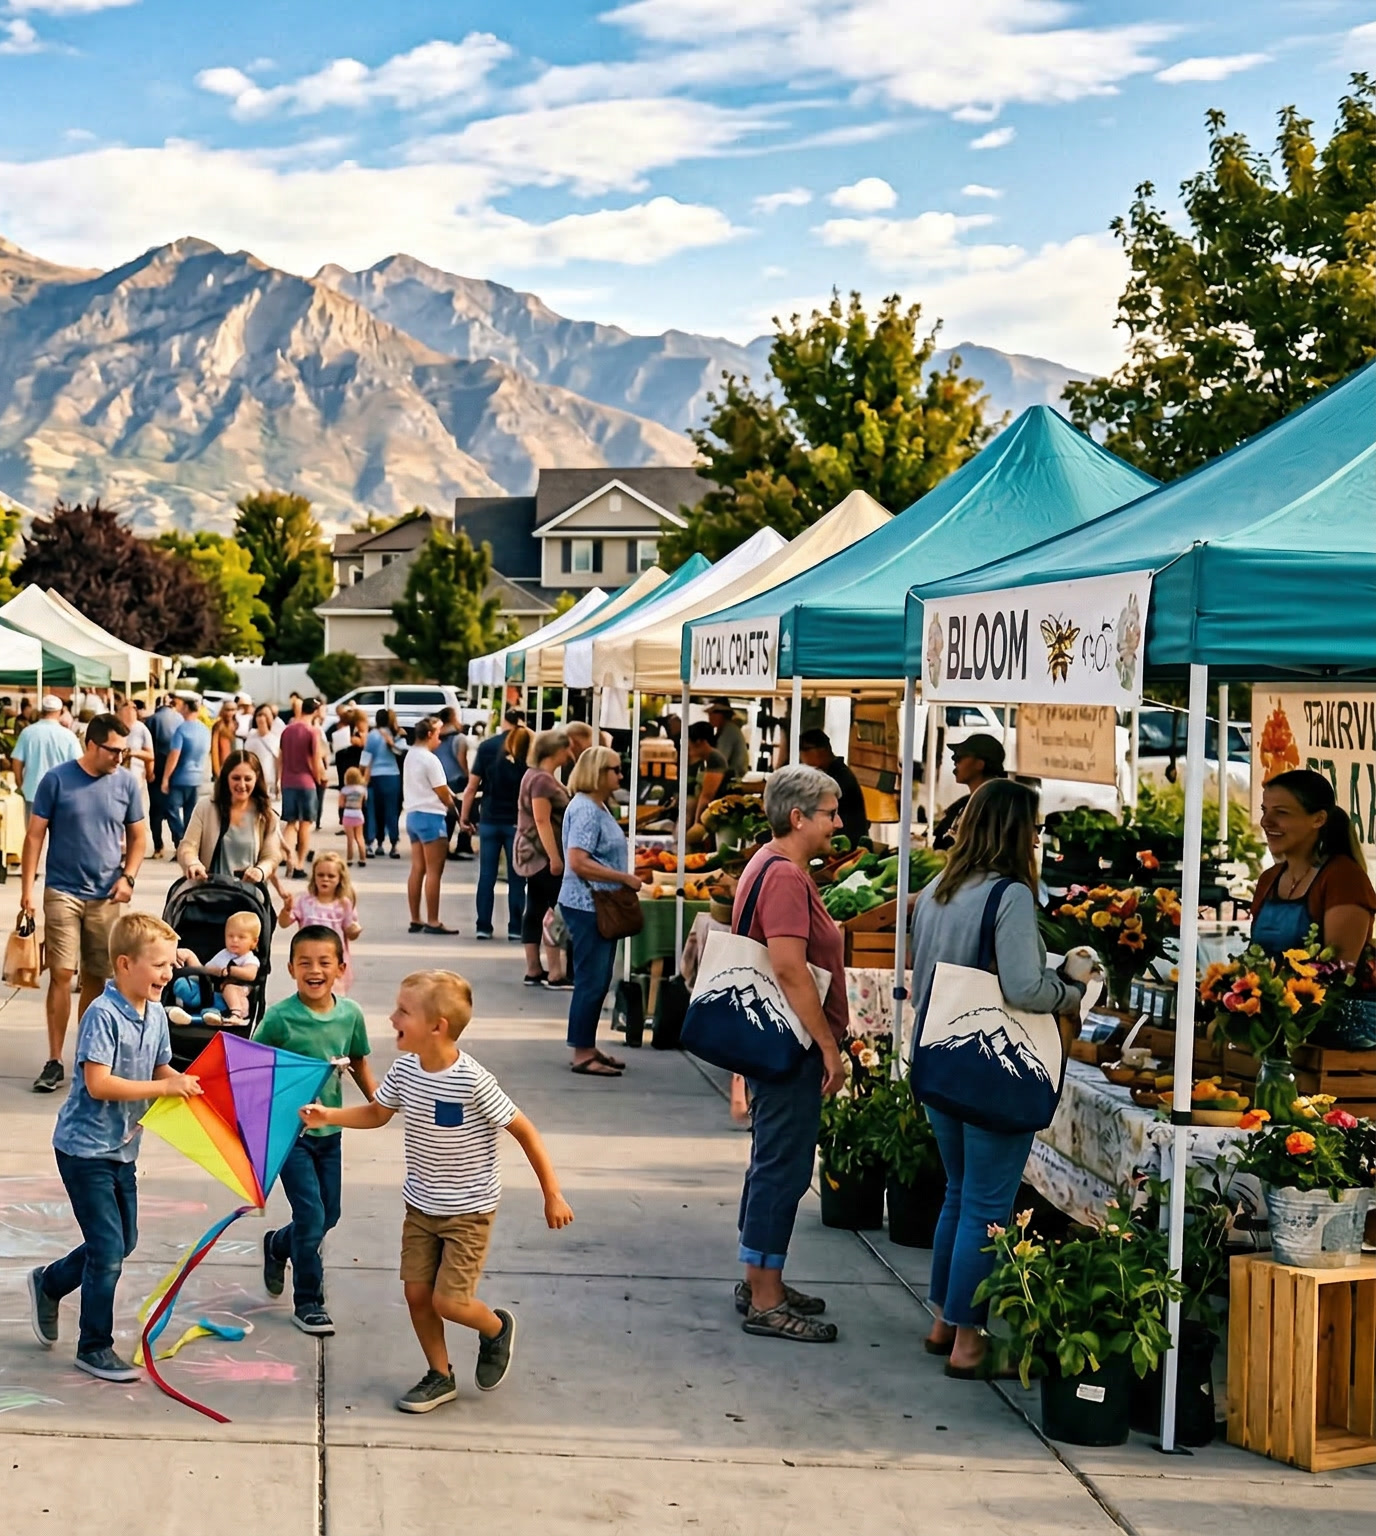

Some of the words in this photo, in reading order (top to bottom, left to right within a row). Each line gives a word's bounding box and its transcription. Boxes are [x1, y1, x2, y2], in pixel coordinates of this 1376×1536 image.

[701, 636, 727, 675] LOCAL
[729, 630, 769, 675] CRAFTS
[946, 609, 1029, 681] BLOOM
